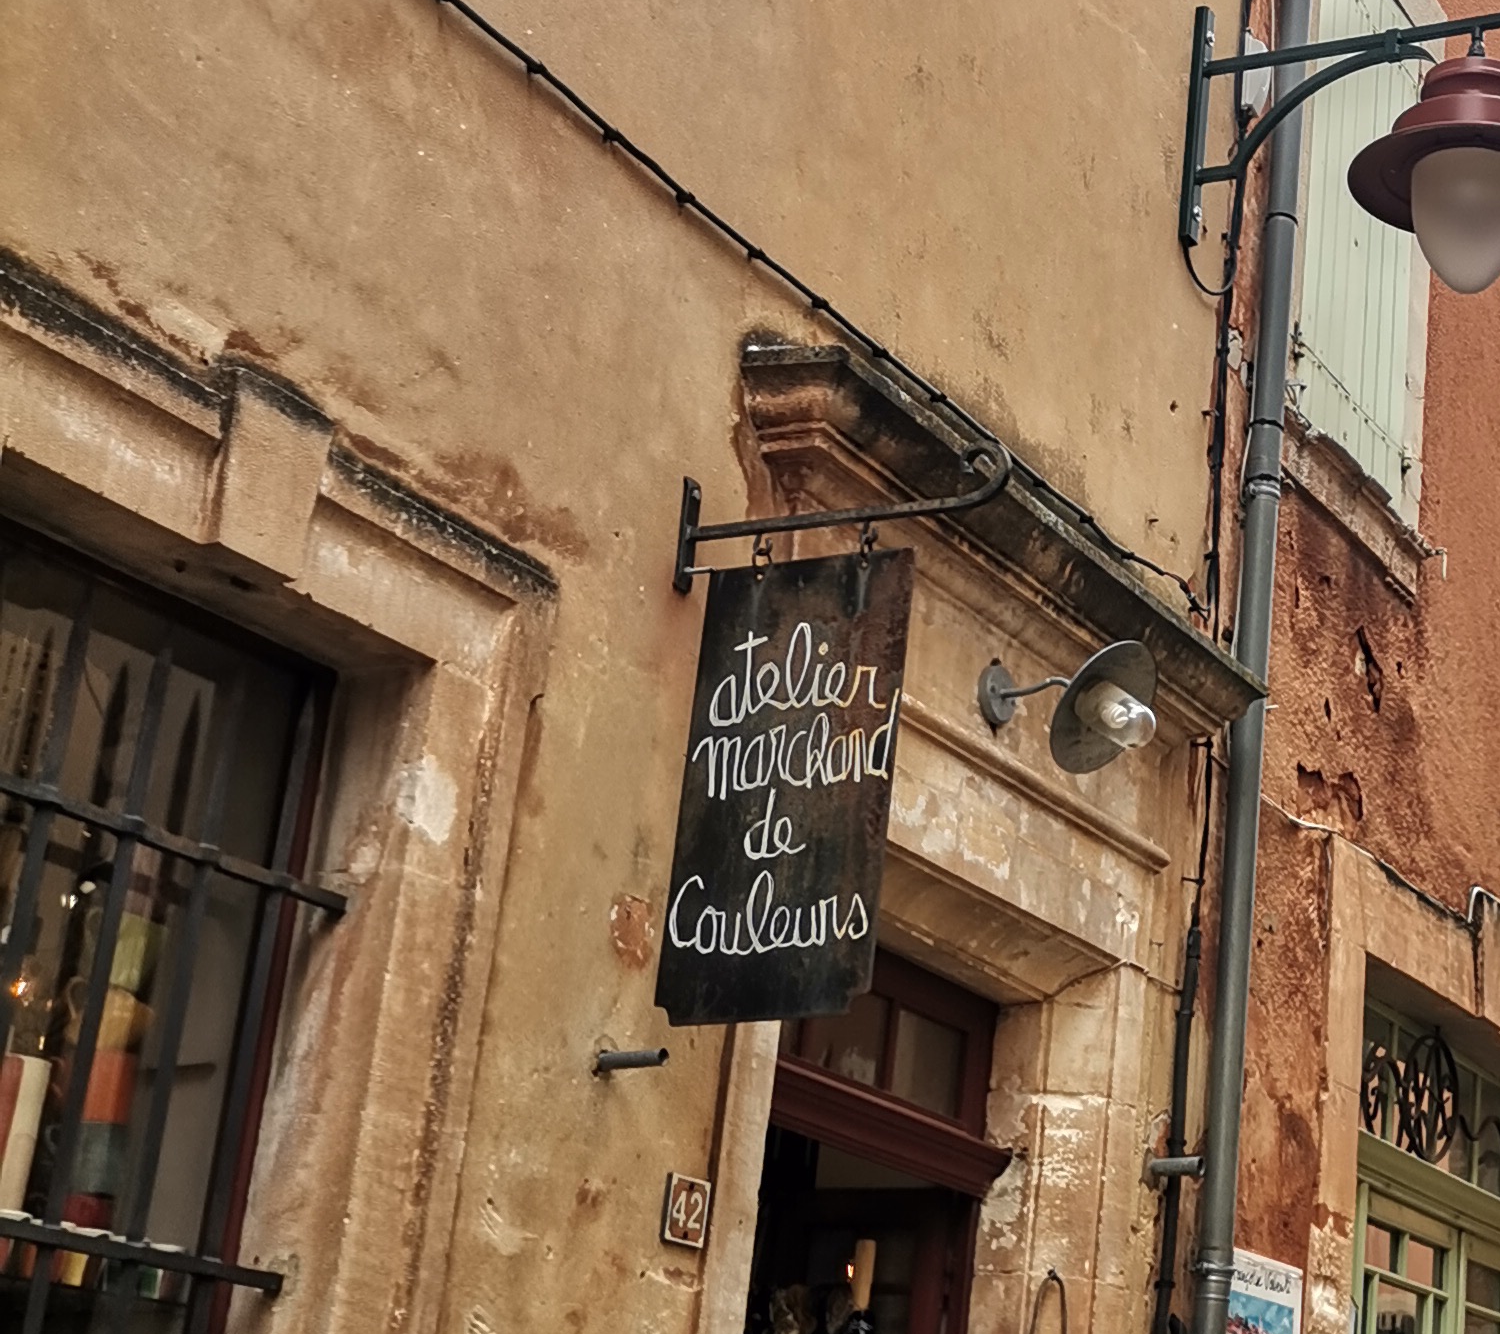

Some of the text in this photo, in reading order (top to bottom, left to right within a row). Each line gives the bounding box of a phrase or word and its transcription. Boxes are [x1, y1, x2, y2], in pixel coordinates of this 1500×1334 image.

[709, 622, 887, 727] atelier
[692, 688, 900, 800] marchand
[743, 788, 806, 860] de
[669, 870, 869, 956] Couleurs
[672, 1190, 703, 1230] 42
